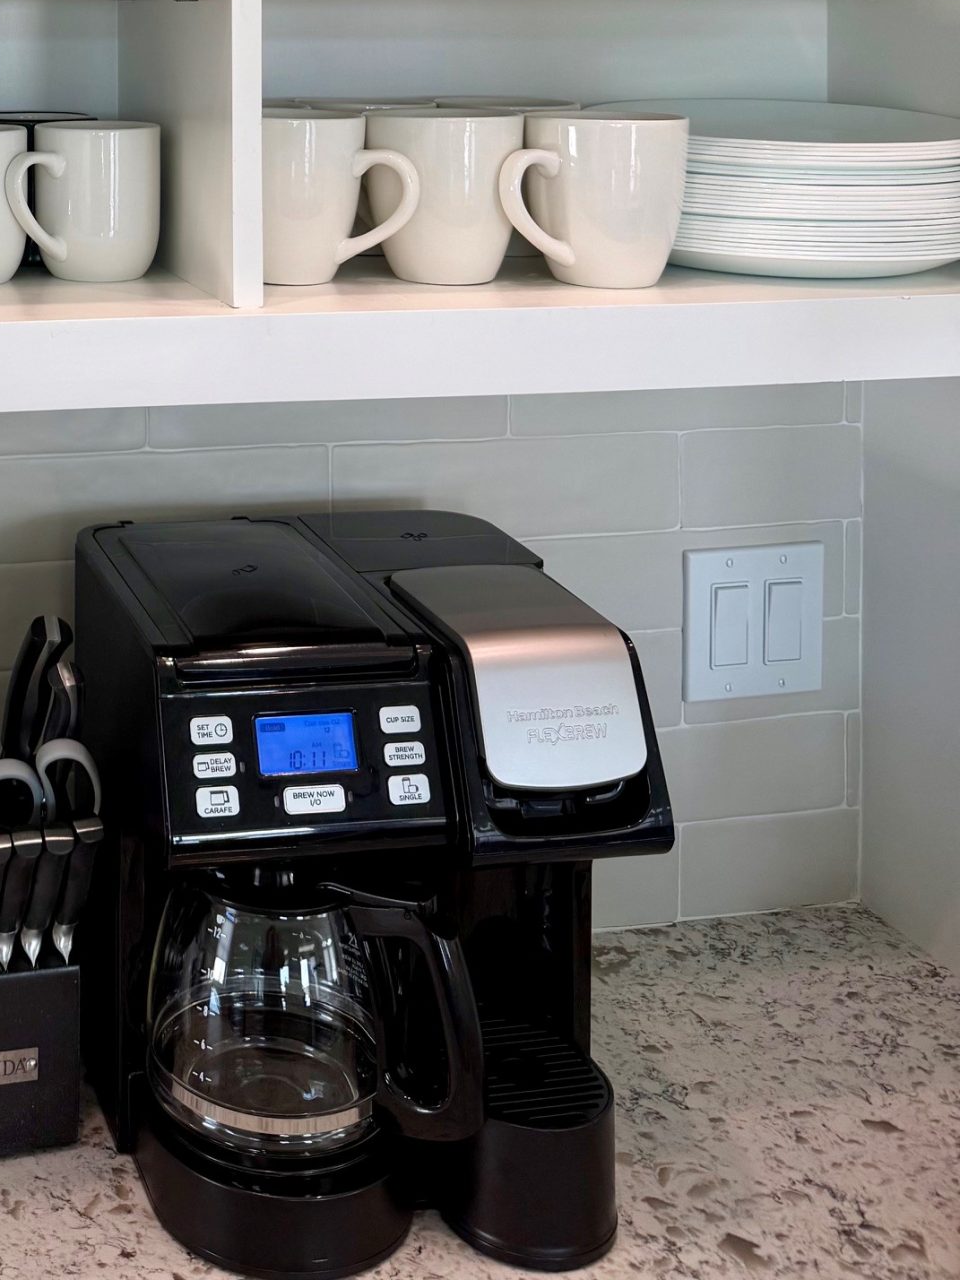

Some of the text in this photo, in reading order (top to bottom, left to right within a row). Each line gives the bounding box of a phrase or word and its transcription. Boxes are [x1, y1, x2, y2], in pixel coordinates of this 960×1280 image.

[506, 703, 620, 723] Hamilton Beach
[385, 715, 415, 724] CUP SIZE
[196, 723, 210, 732] SET
[197, 731, 213, 739] TIME
[395, 745, 415, 753] BREW
[210, 757, 232, 766] DELAY
[289, 751, 326, 770] 10:11
[388, 753, 423, 761] STRENGTH
[210, 765, 232, 773] BREW
[292, 789, 335, 800] BREW NOW
[399, 793, 423, 801] SINGLE
[203, 806, 233, 815] CARAFE
